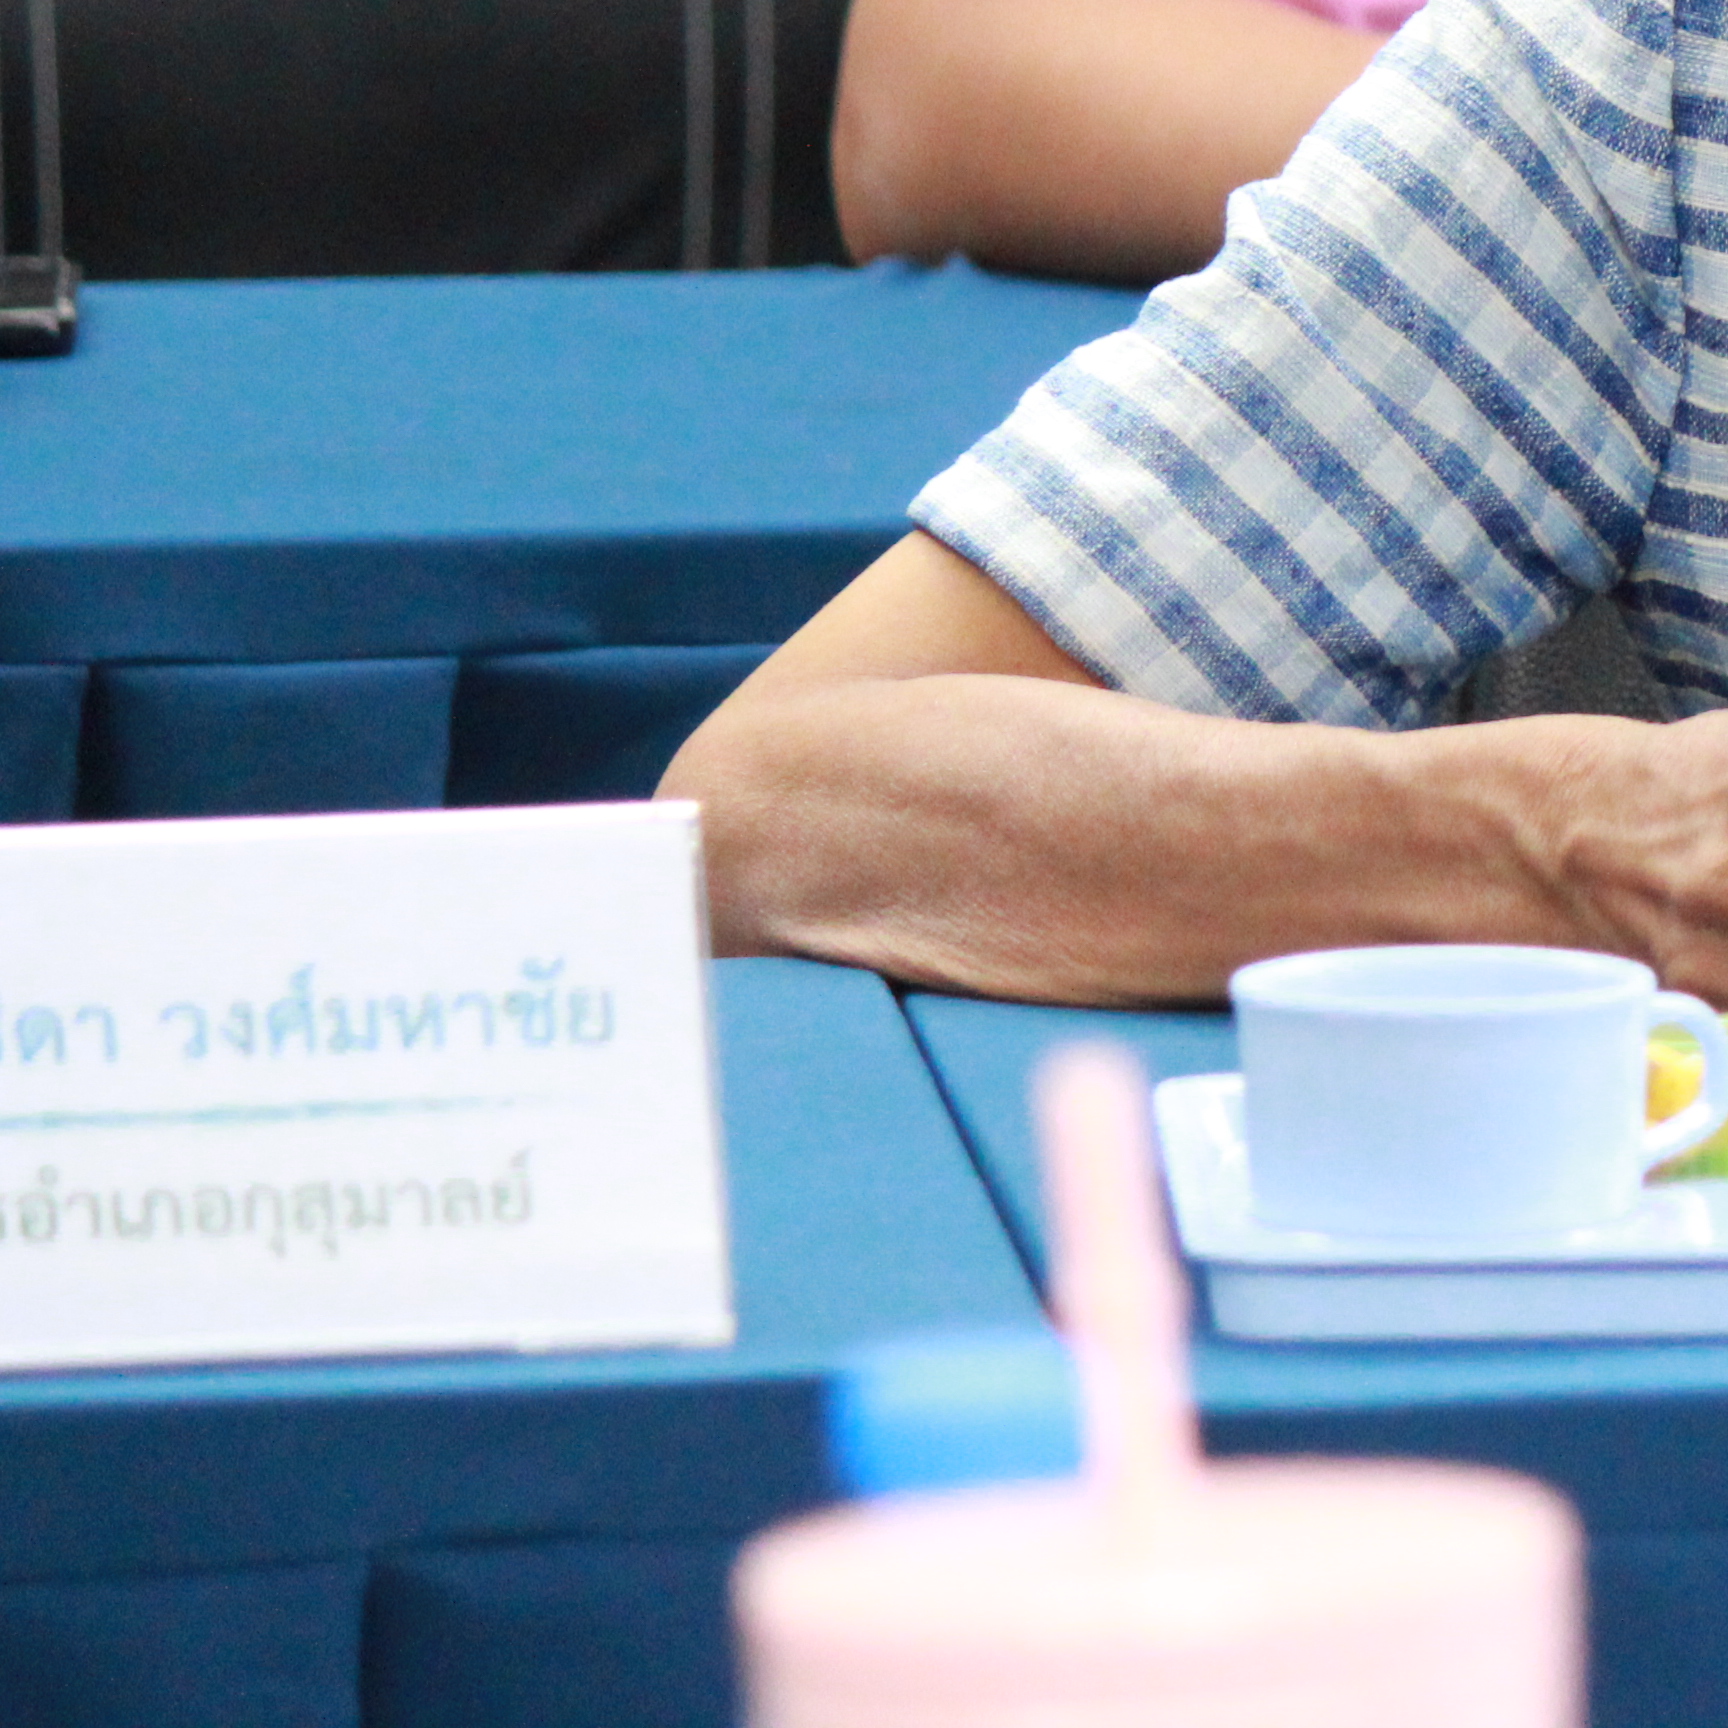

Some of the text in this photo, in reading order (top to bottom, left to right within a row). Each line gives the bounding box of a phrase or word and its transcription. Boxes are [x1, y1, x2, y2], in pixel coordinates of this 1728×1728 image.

[0, 954, 616, 1065] ดา วงศ์มหาชัย
[0, 1146, 535, 1259] อำเภอกุสุมาลย์
